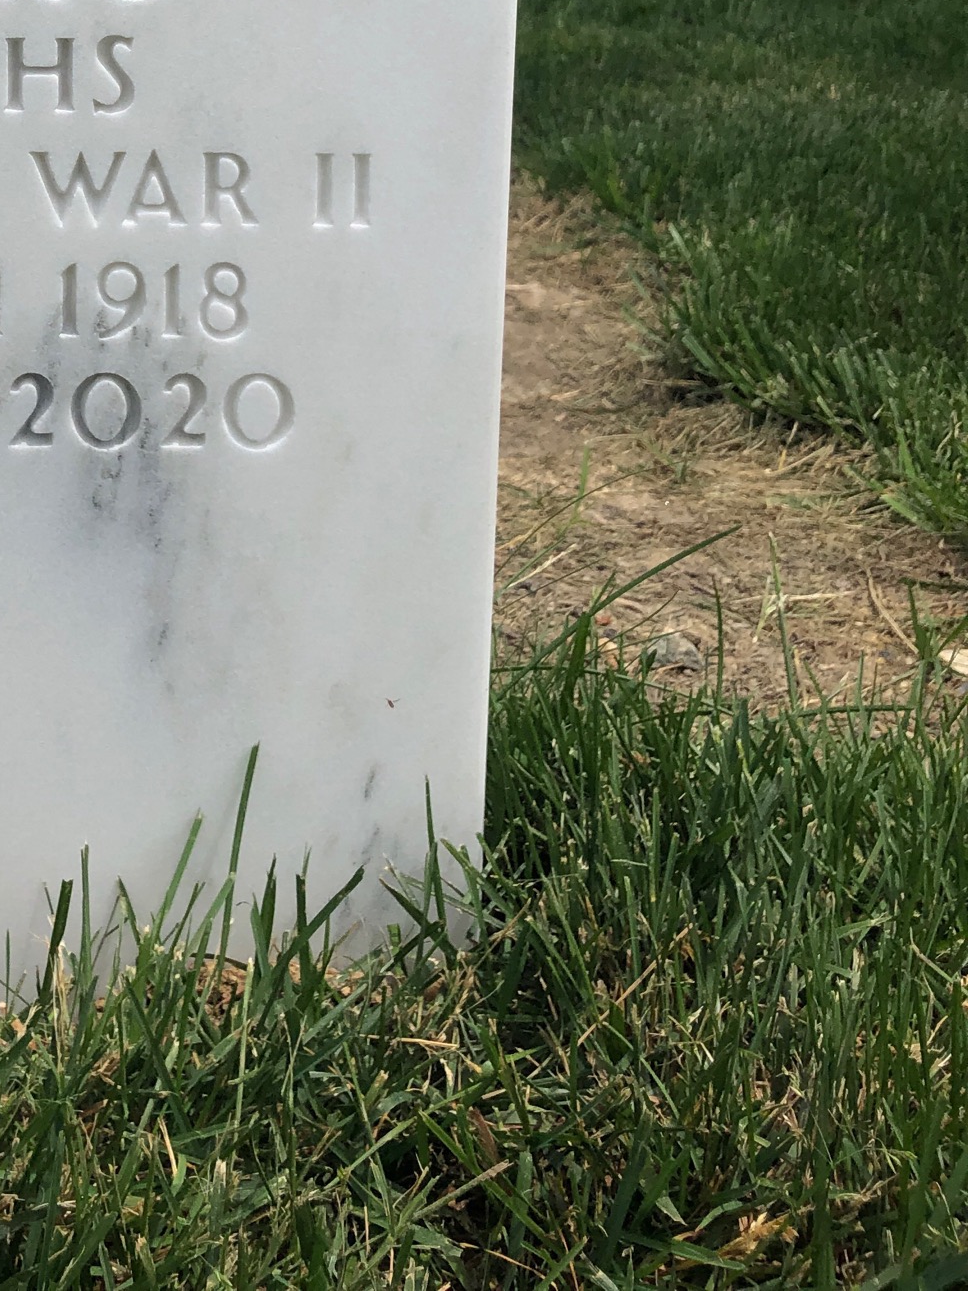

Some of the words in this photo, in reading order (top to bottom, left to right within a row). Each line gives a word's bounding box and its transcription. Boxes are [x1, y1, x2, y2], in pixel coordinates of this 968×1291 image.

[29, 150, 260, 229] WAR
[312, 152, 373, 229] II
[58, 261, 251, 342] 1918
[8, 372, 296, 453] 2020
